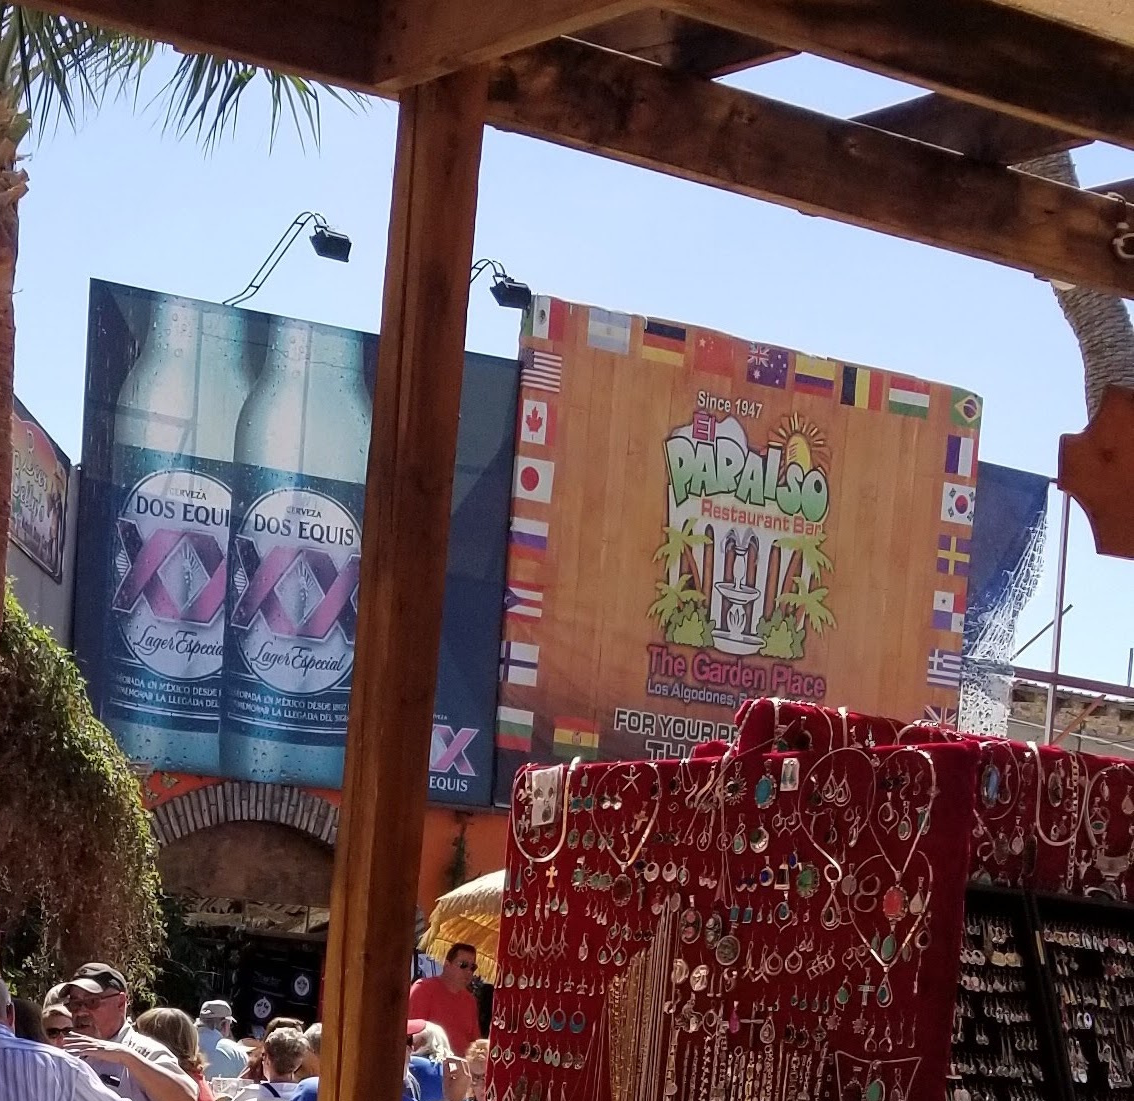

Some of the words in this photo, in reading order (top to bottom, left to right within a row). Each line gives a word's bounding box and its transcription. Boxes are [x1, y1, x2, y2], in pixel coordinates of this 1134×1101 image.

[697, 390, 731, 412] Since
[735, 398, 763, 419] 1947
[692, 411, 716, 442] El
[135, 495, 175, 519] DOS
[181, 503, 230, 527] EQUI
[286, 505, 322, 518] CERVEZA
[701, 498, 789, 530] Restaurant
[793, 515, 823, 536] Bar
[254, 513, 291, 537] DOS
[298, 521, 354, 546] EQUIS
[133, 625, 175, 656] Lager
[176, 630, 223, 662] Especia
[250, 641, 291, 671] Lager
[291, 646, 346, 677] Especial
[646, 644, 686, 677] The
[692, 651, 766, 691] Garden
[771, 664, 826, 698] Place
[647, 679, 669, 697] Los
[670, 683, 738, 709] Algodones,
[614, 708, 655, 736] FOR
[658, 714, 715, 744] YOUR
[429, 776, 468, 792] EQUIS
